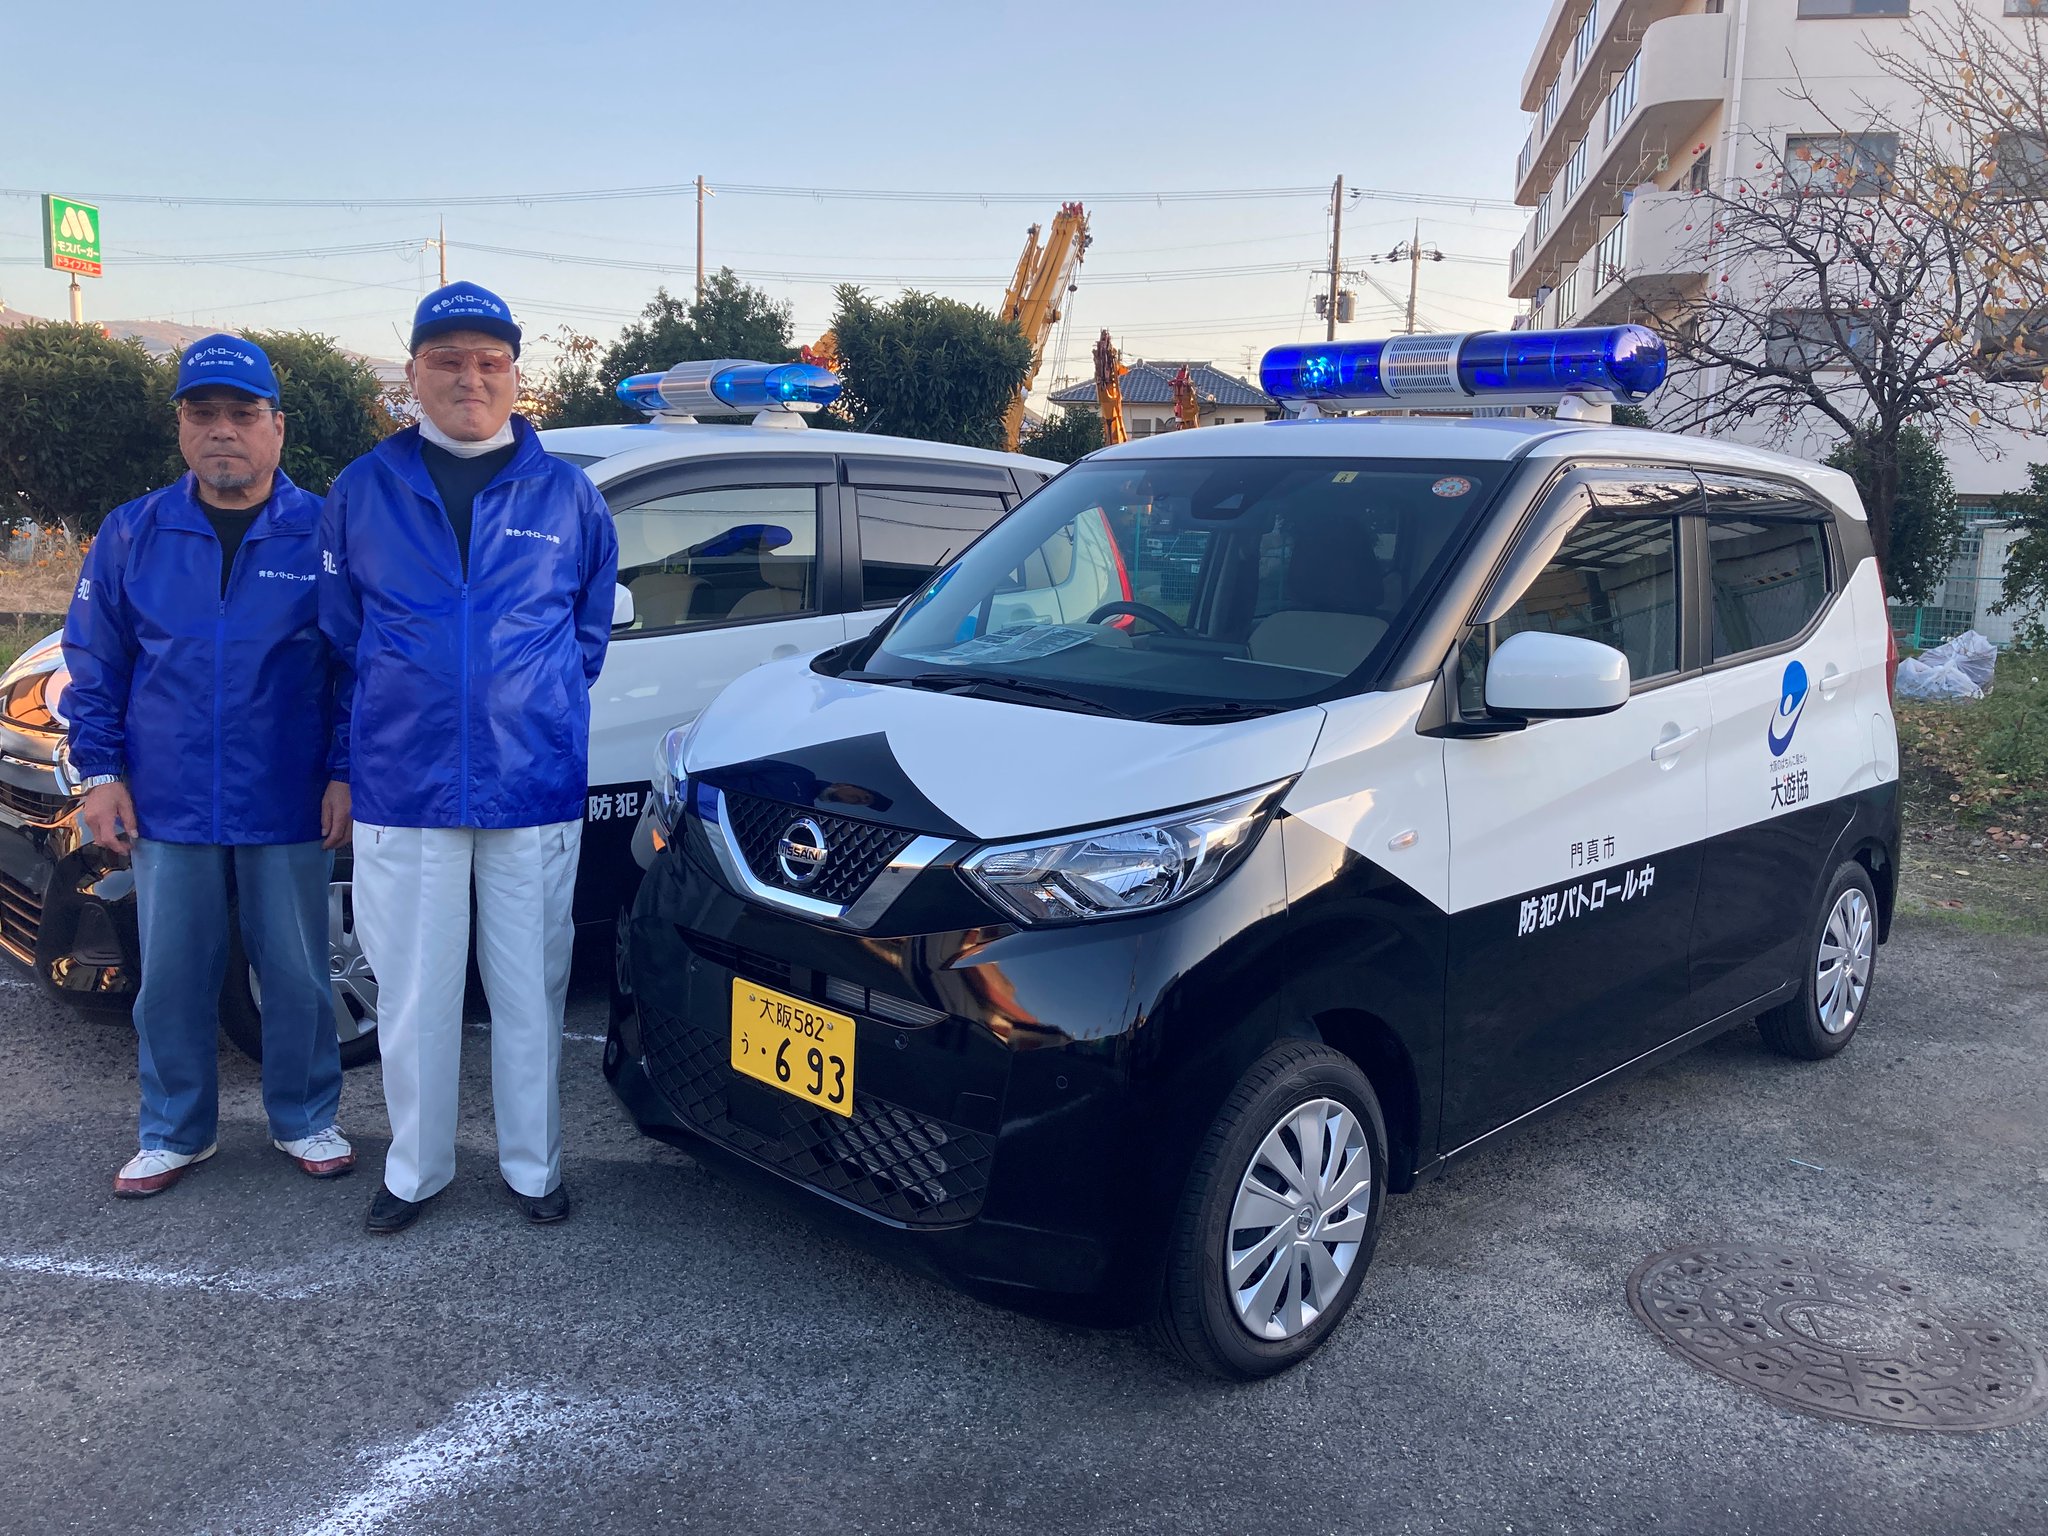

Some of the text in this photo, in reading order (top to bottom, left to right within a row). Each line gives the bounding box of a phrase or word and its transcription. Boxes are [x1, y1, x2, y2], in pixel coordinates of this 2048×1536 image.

[57, 240, 99, 258] モスバーガー
[431, 294, 501, 314] 青色パトロール隊
[187, 347, 255, 366] 青色パトロール隊
[77, 577, 90, 601] 犯
[1770, 768, 1809, 811] 大遊協
[780, 844, 818, 861] NISSAN
[1570, 835, 1615, 869] 門真市
[1517, 863, 1656, 937] 防犯パトロール中
